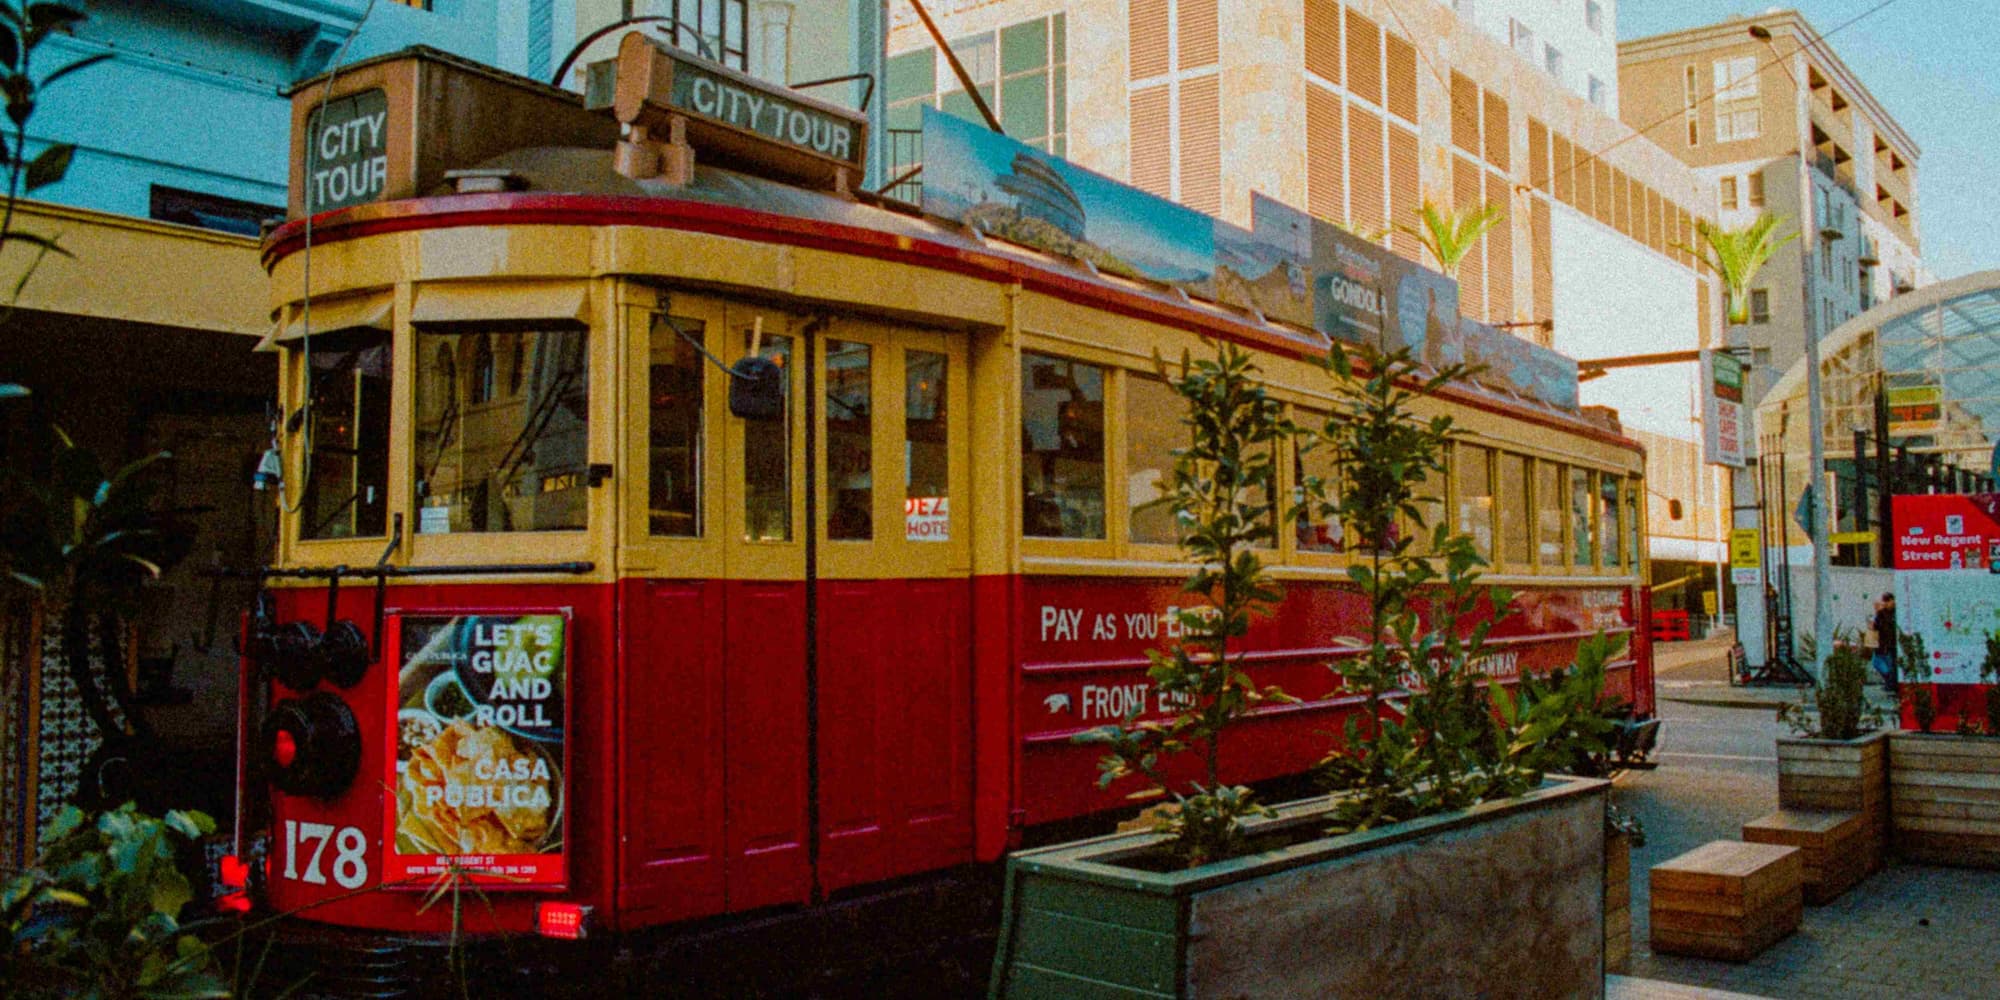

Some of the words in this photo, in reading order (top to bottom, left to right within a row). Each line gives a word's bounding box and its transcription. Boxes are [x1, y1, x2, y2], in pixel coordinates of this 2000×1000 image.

[693, 77, 765, 130] CITY
[770, 103, 851, 160] TOUR
[321, 111, 386, 160] CITY
[315, 155, 388, 206] TOUR
[1901, 535, 1930, 546] New
[1934, 534, 1981, 548] Regent
[1902, 550, 1944, 561] Street
[475, 624, 553, 647] LET'S
[1041, 605, 1083, 642] PAY
[1092, 613, 1117, 641] AS
[1124, 612, 1158, 640] YOU
[472, 651, 553, 674] GUAC
[489, 677, 552, 700] AND
[1082, 684, 1149, 720] FRONT
[477, 703, 552, 728] ROLL
[475, 757, 551, 781] CASA
[283, 818, 369, 890] 178
